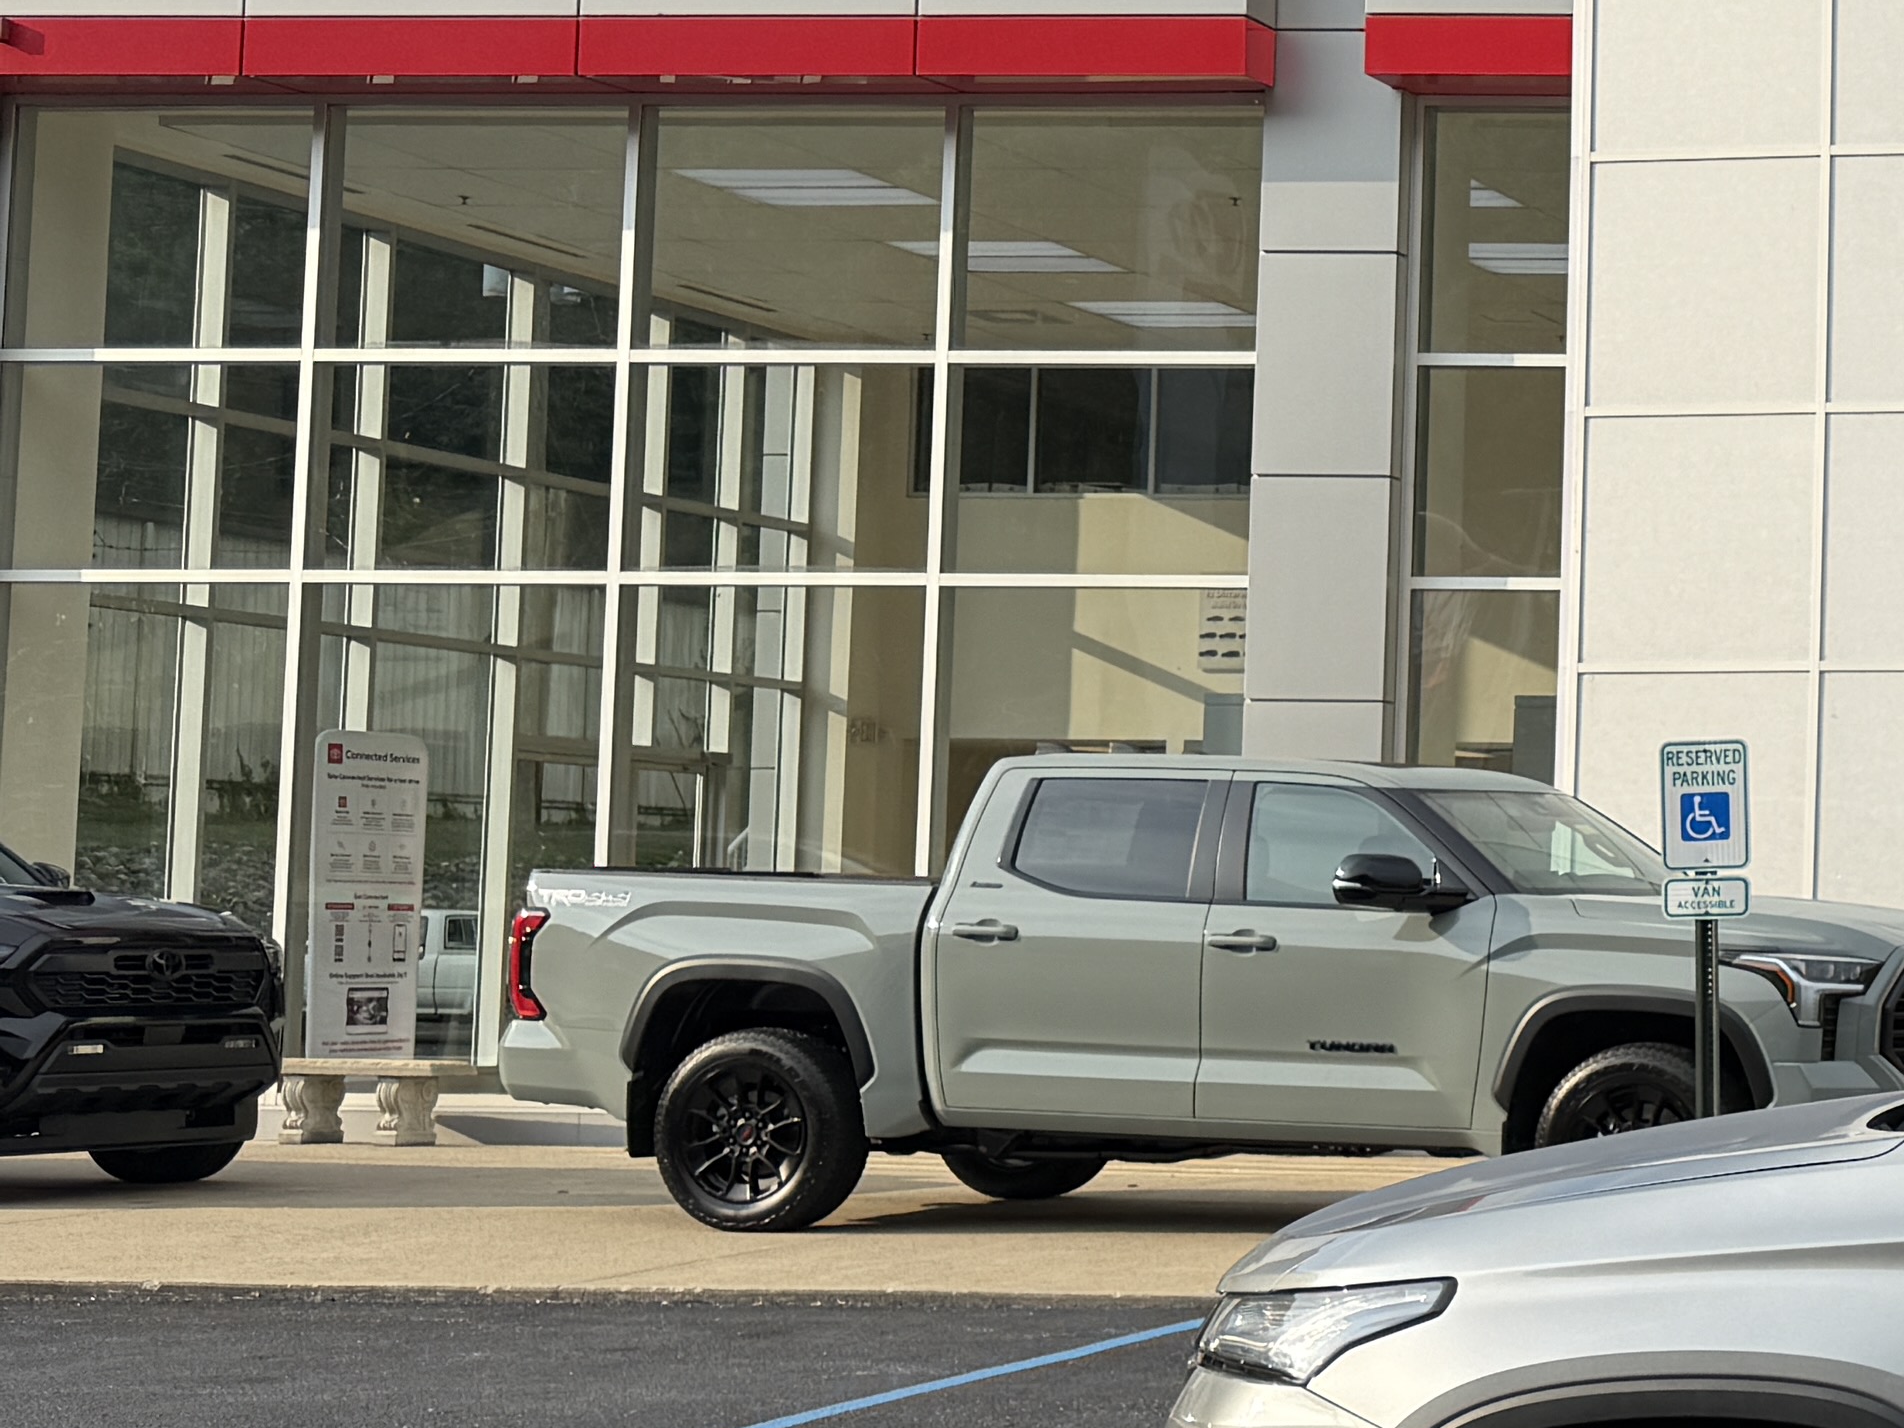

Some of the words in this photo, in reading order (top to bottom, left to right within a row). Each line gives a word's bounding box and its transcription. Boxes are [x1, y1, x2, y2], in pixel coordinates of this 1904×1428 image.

[345, 749, 388, 762] Connected
[389, 753, 420, 764] Services
[1666, 748, 1742, 767] RESERVED
[1672, 769, 1737, 787] PARKING
[1691, 885, 1721, 898] VAN
[1677, 899, 1735, 910] ACCESSIBLE
[1306, 1039, 1397, 1054] TUNDRA
